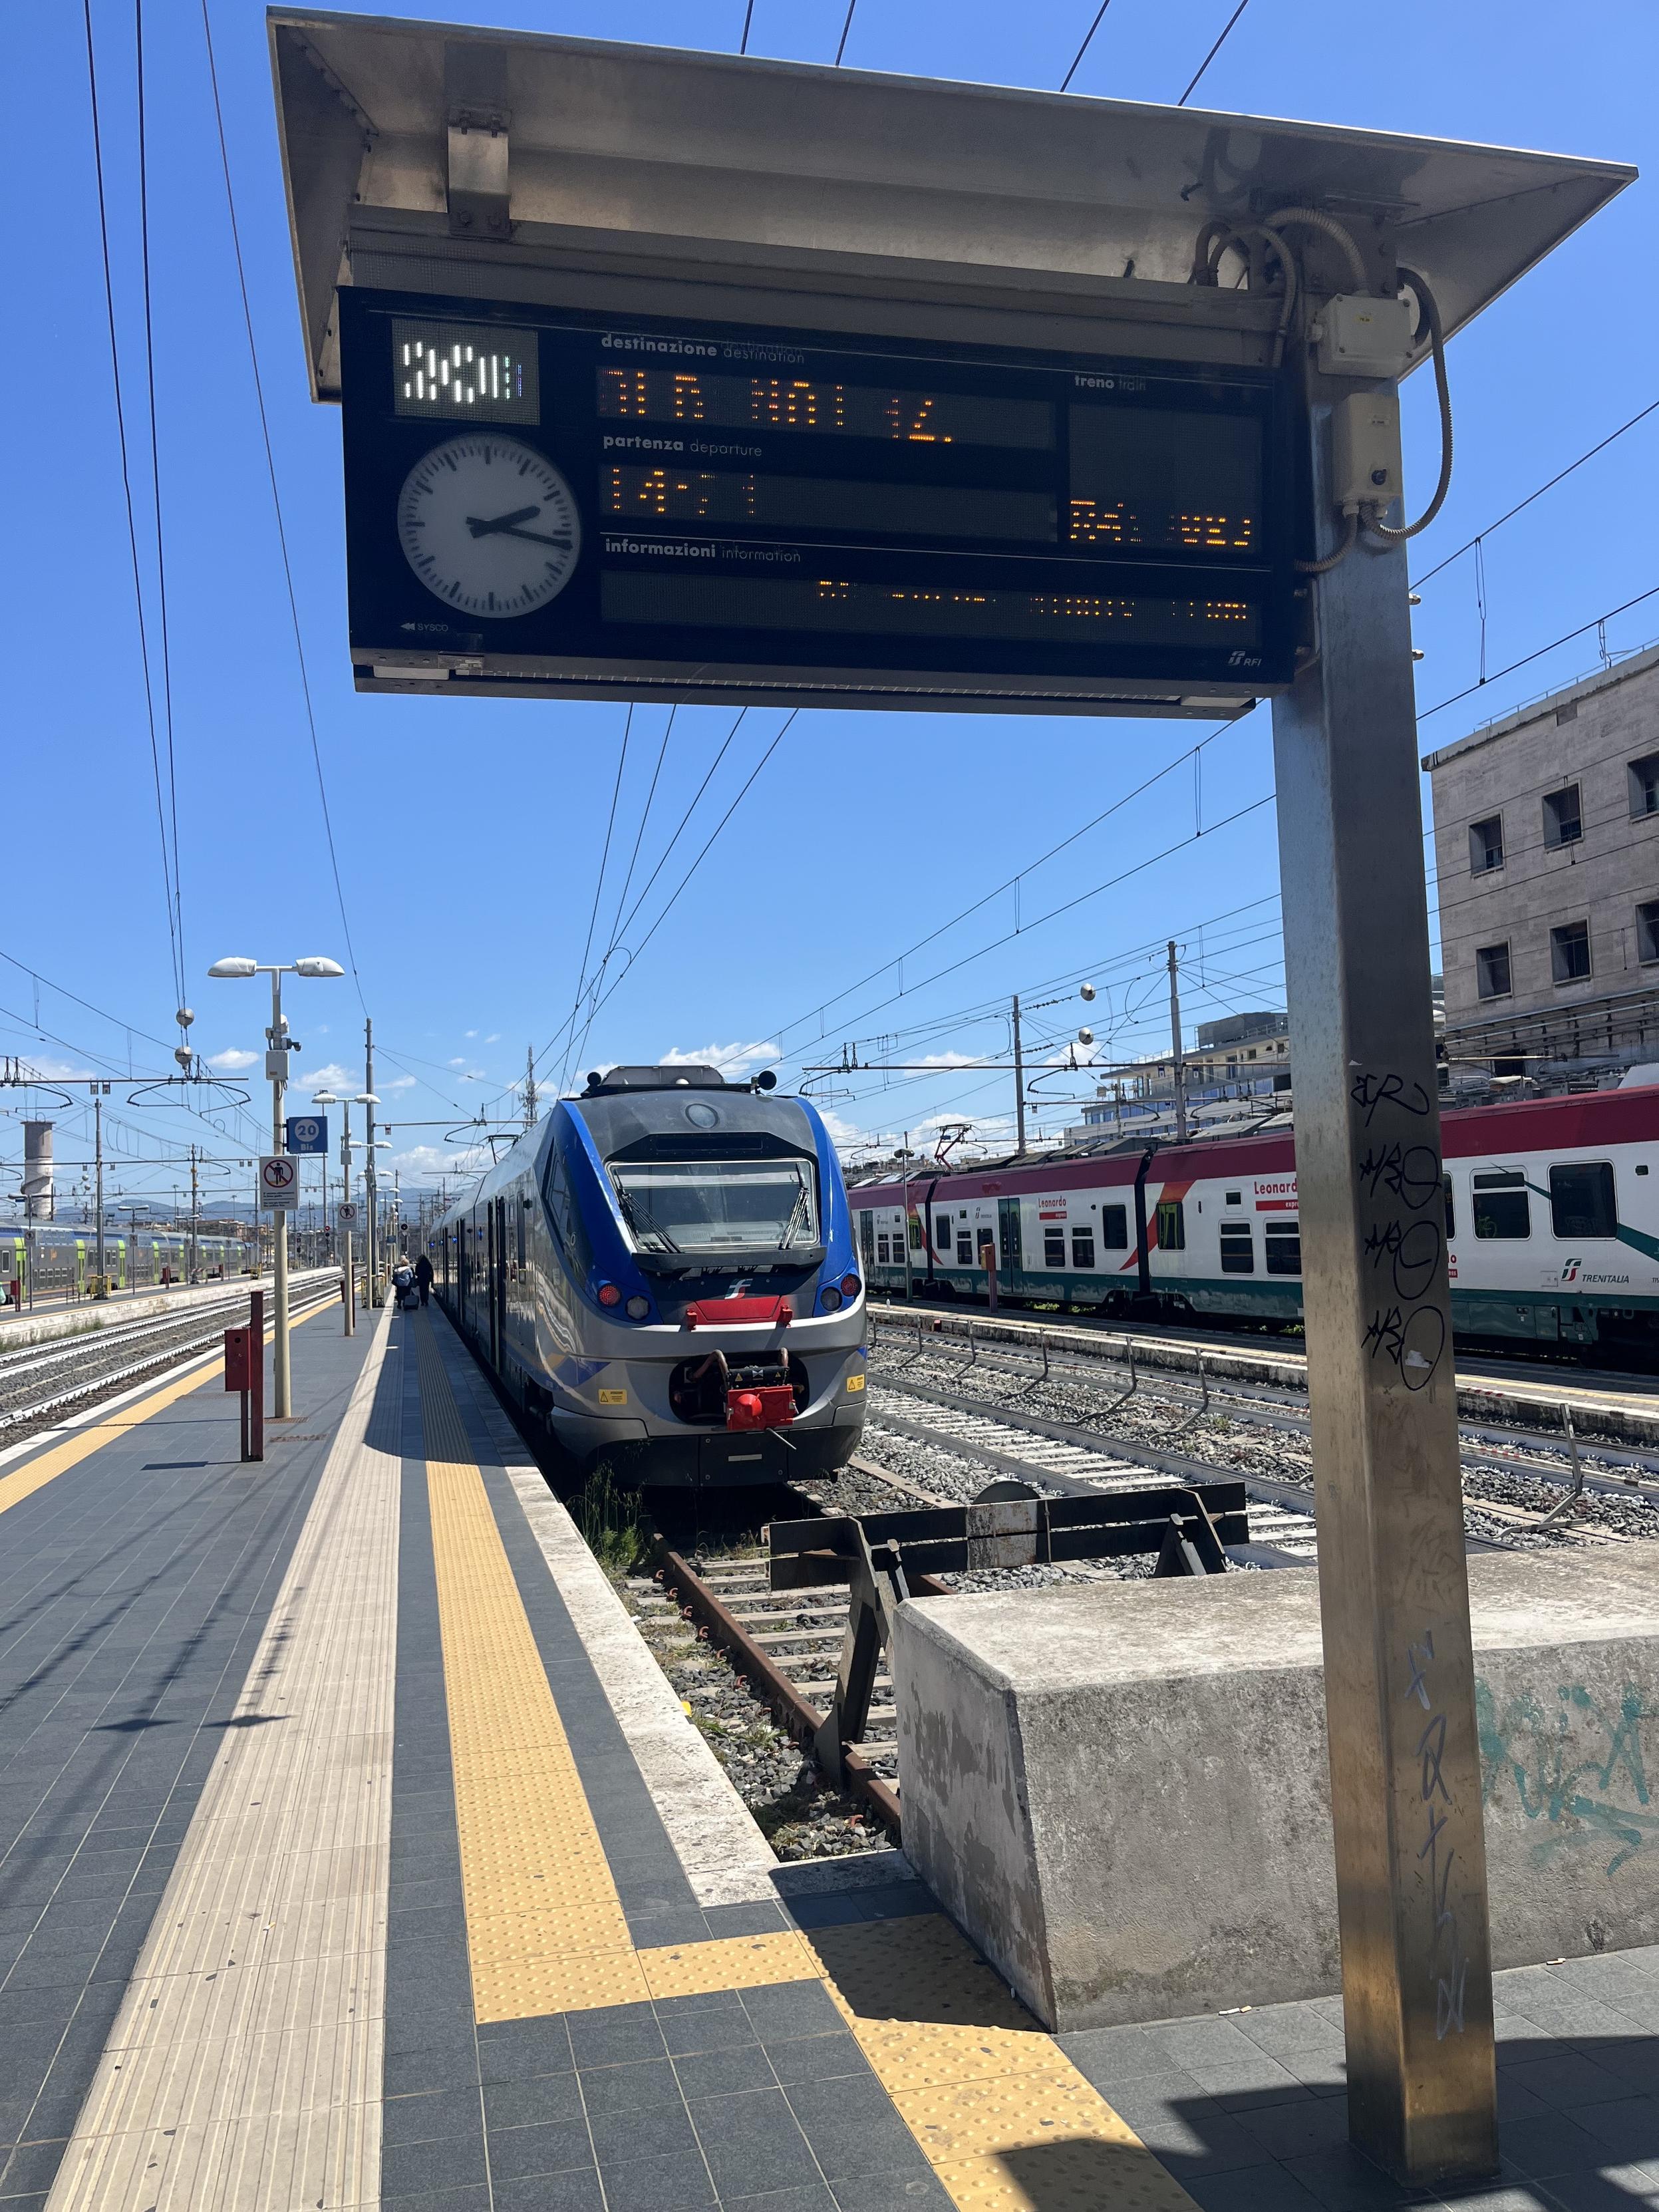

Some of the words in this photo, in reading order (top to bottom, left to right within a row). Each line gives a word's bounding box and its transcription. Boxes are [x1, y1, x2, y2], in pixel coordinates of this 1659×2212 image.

[601, 333, 718, 357] destinazione
[723, 347, 805, 363] destination
[1074, 375, 1114, 389] treno
[603, 436, 684, 451] partenza
[690, 439, 762, 456] departure
[605, 539, 716, 557] informazioni
[722, 546, 801, 562] information
[417, 623, 449, 632] SYSCO
[297, 1124, 317, 1136] 20
[1254, 1178, 1298, 1195] Leonard
[1038, 1195, 1066, 1208] Leonardo
[1583, 1274, 1629, 1283] TRENITALIA
